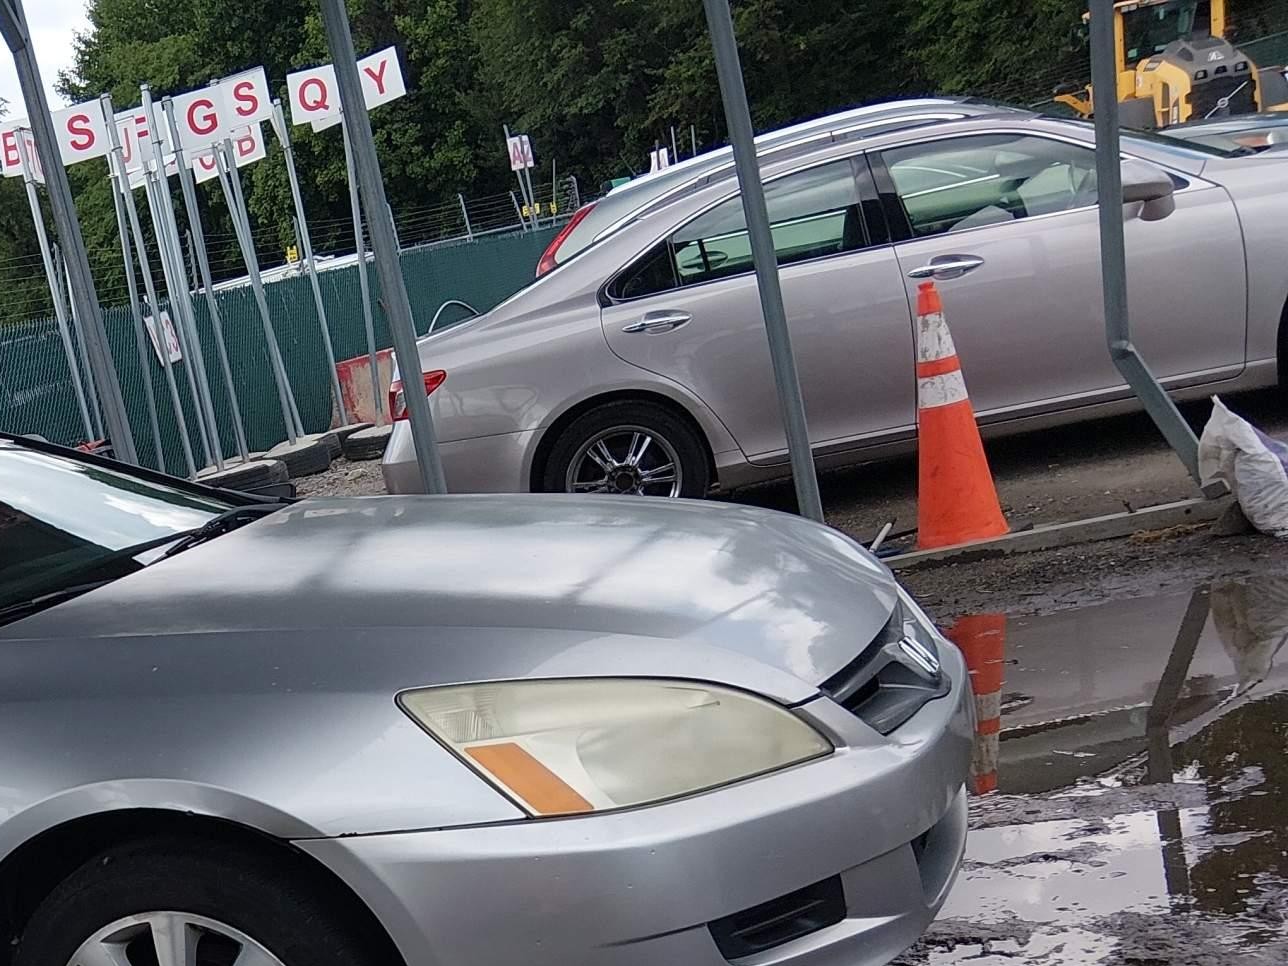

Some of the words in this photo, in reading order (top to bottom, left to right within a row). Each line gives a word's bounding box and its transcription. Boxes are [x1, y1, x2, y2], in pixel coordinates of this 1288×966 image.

[299, 78, 330, 112] Q
[364, 59, 387, 95] Y
[233, 81, 259, 117] S
[67, 114, 95, 151] S
[187, 99, 218, 136] G
